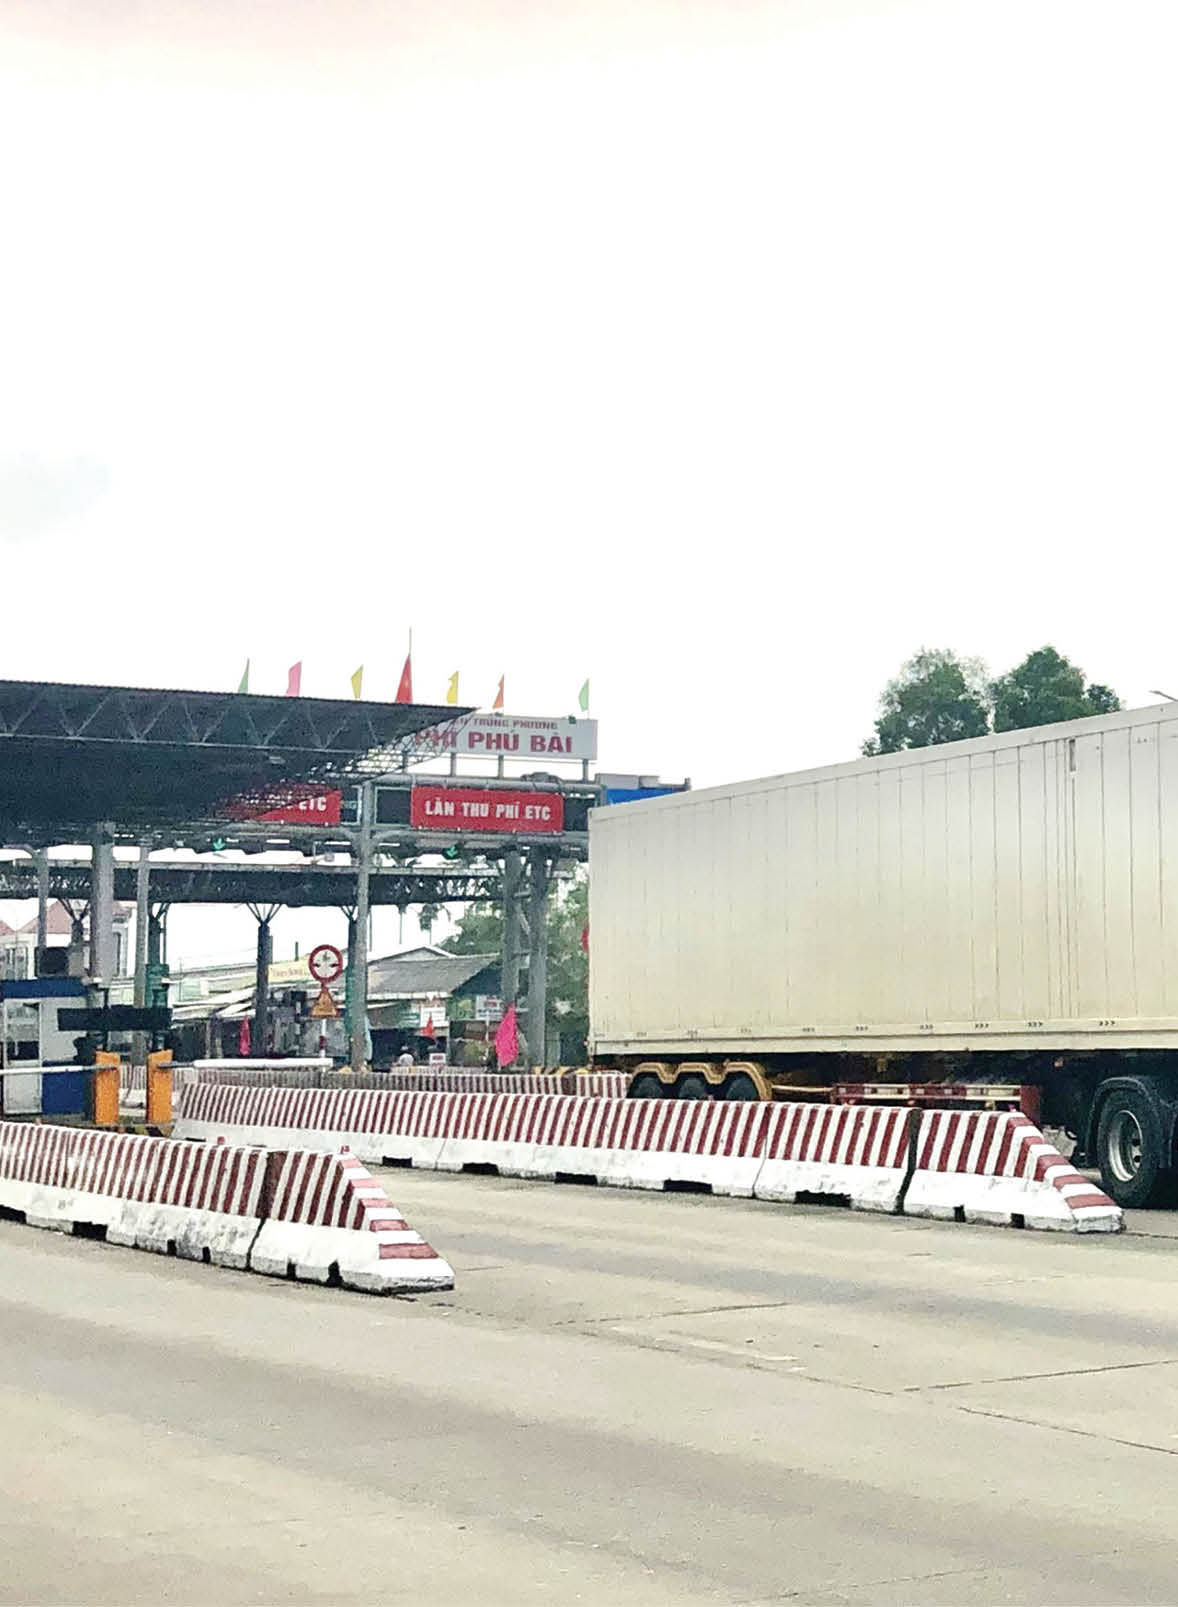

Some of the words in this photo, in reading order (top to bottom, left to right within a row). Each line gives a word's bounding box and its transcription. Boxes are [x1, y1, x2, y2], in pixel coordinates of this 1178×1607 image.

[468, 730, 520, 751] PHÚ
[462, 802, 489, 817] THU
[496, 802, 519, 819] PHÍ
[525, 805, 551, 820] ETC
